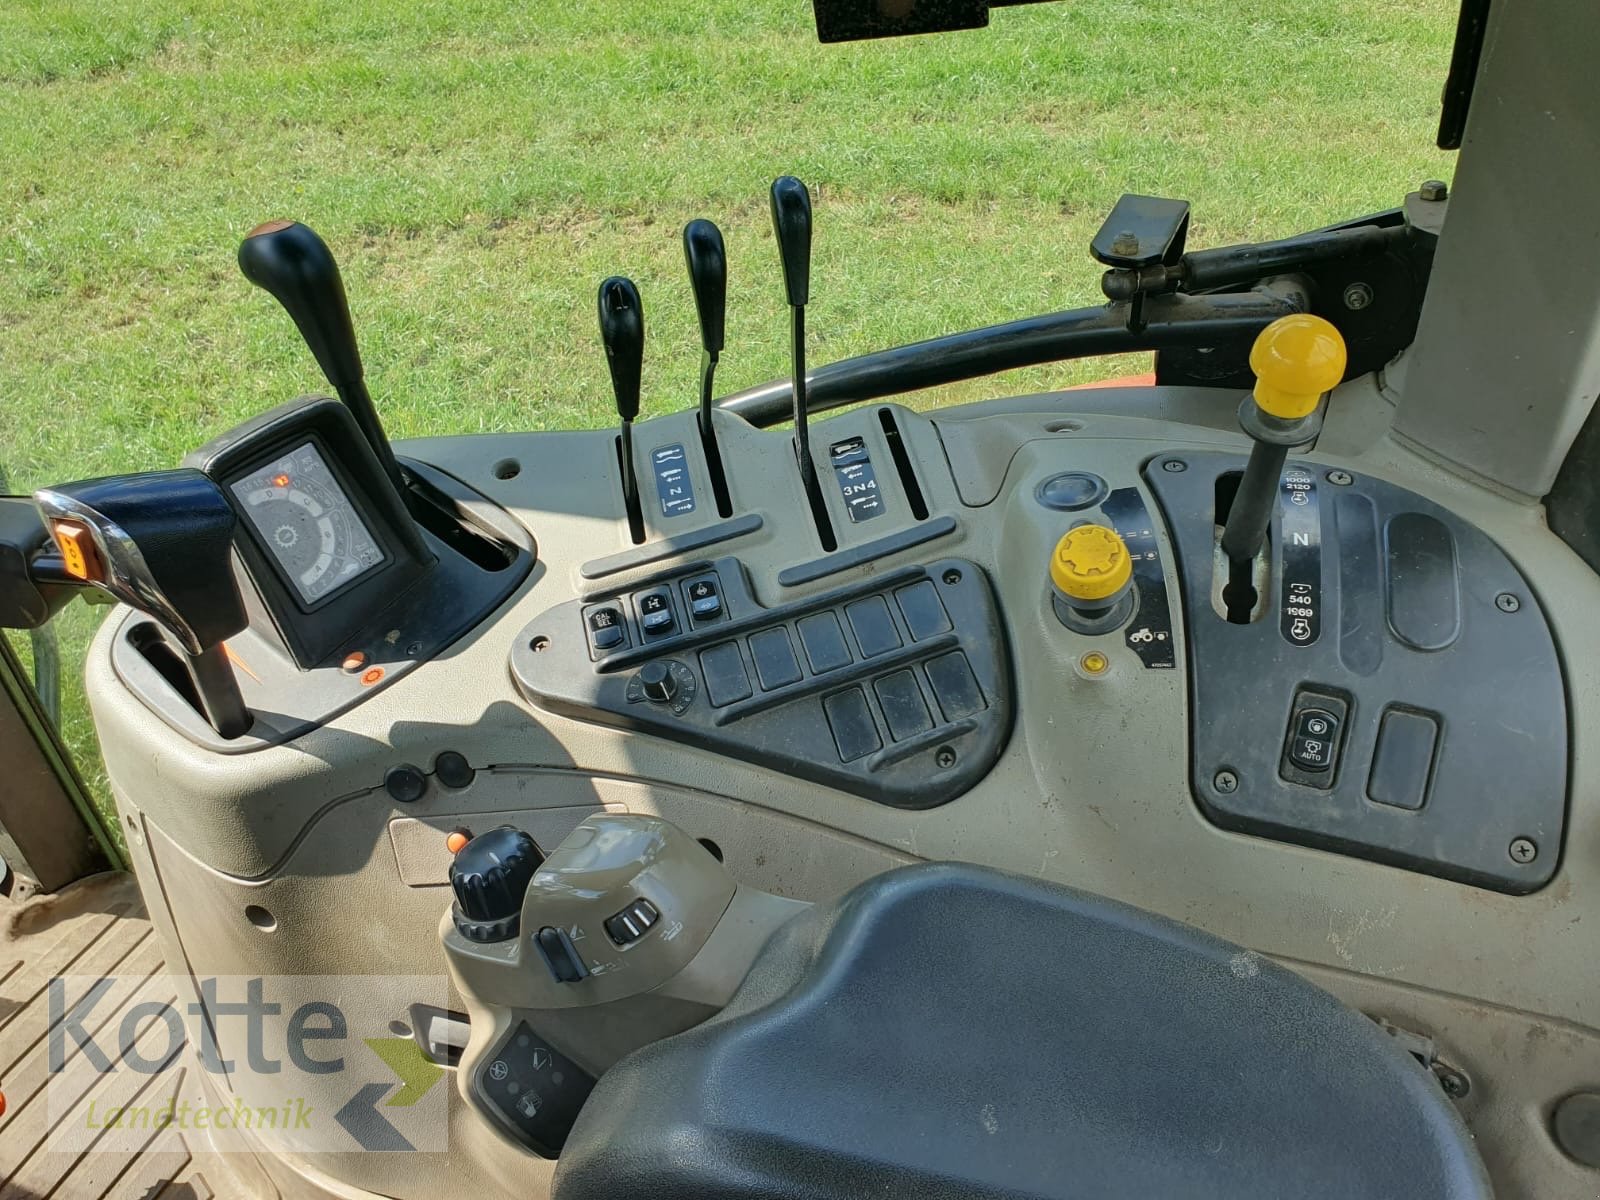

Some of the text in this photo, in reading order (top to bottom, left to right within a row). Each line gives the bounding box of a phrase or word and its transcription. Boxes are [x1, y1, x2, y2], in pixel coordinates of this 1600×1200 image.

[1286, 483, 1311, 491] 2120
[1293, 532, 1309, 546] N
[1289, 595, 1312, 605] 540
[595, 612, 610, 620] CAL
[1287, 607, 1313, 617] 1969
[1301, 752, 1321, 761] AUTO
